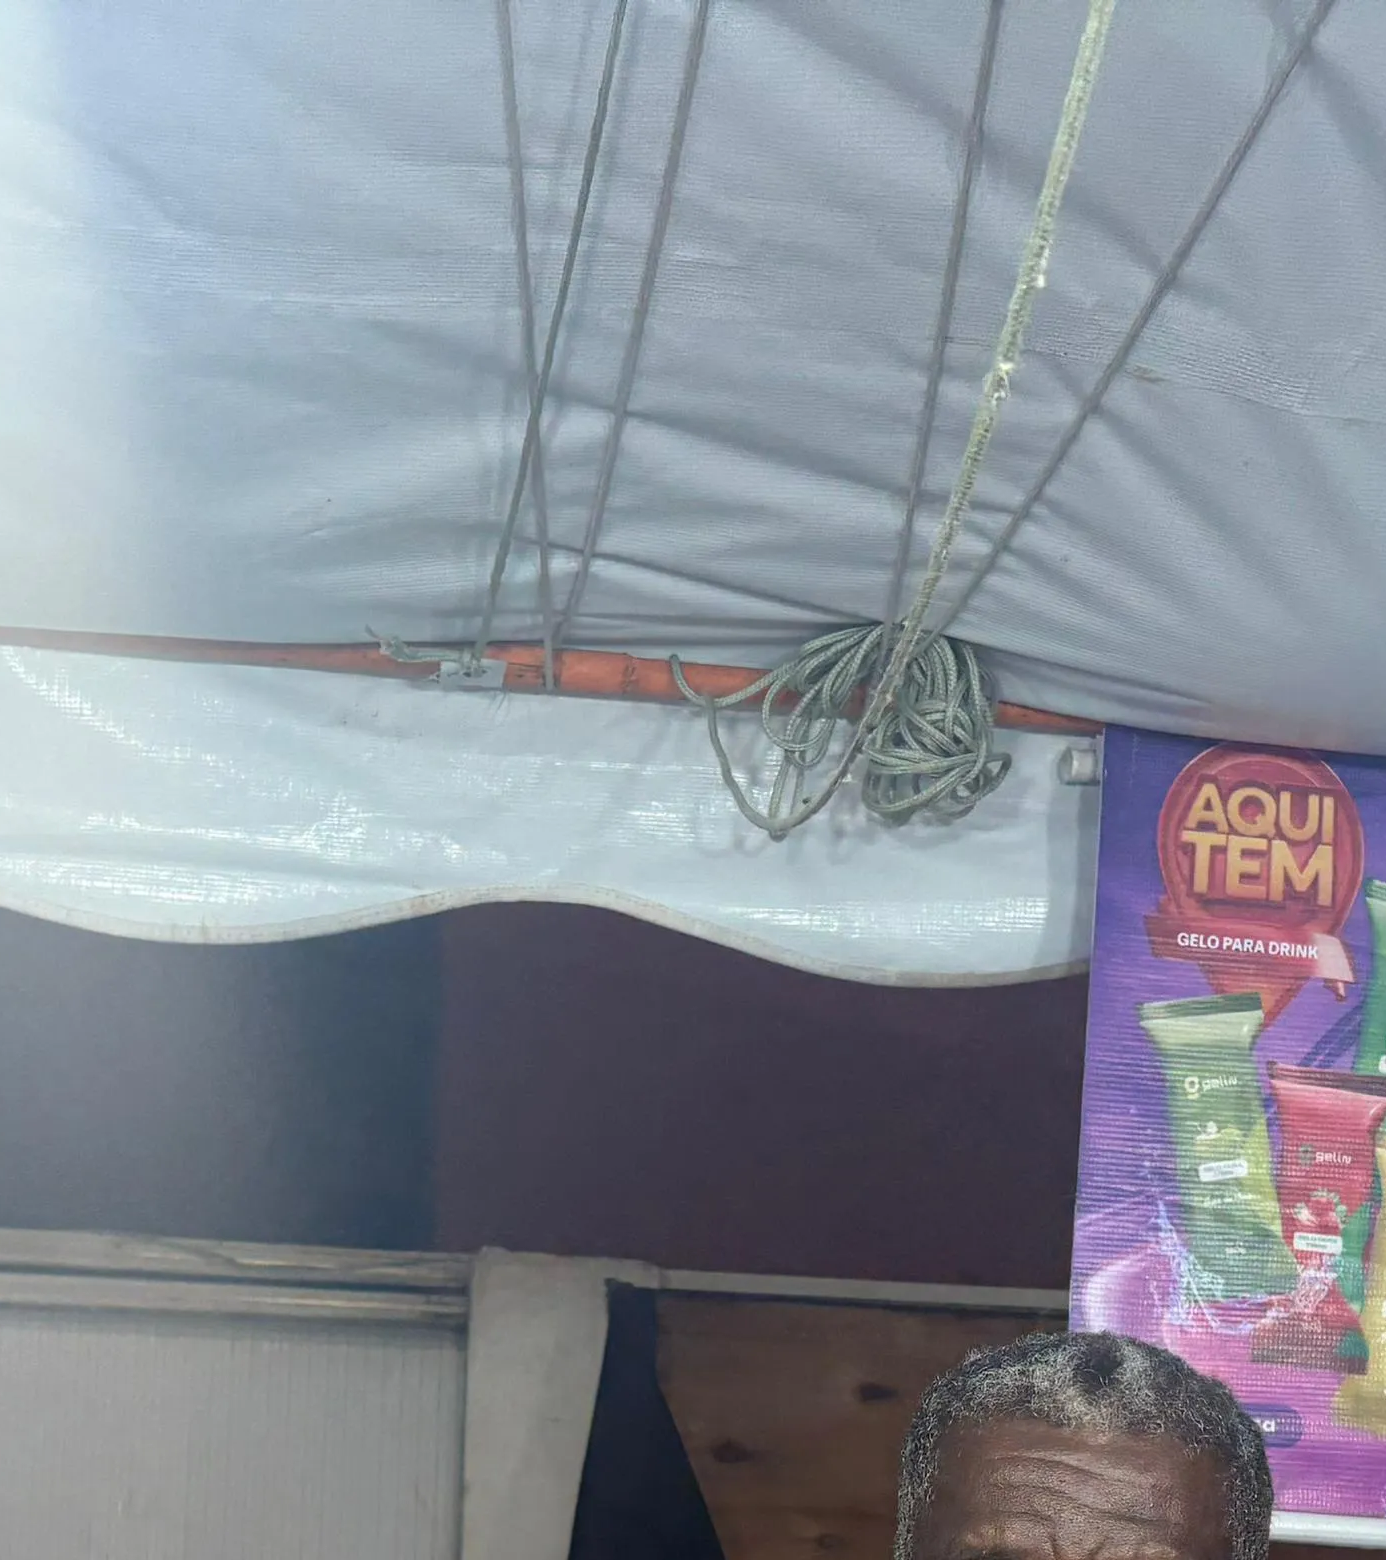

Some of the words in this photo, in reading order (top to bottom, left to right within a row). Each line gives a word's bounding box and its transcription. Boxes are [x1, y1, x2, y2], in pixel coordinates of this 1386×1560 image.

[1184, 783, 1335, 843] AQUI
[1181, 830, 1334, 907] TEM
[1177, 932, 1219, 950] GELO
[1223, 936, 1265, 954] PARA
[1268, 941, 1319, 960] DRINK
